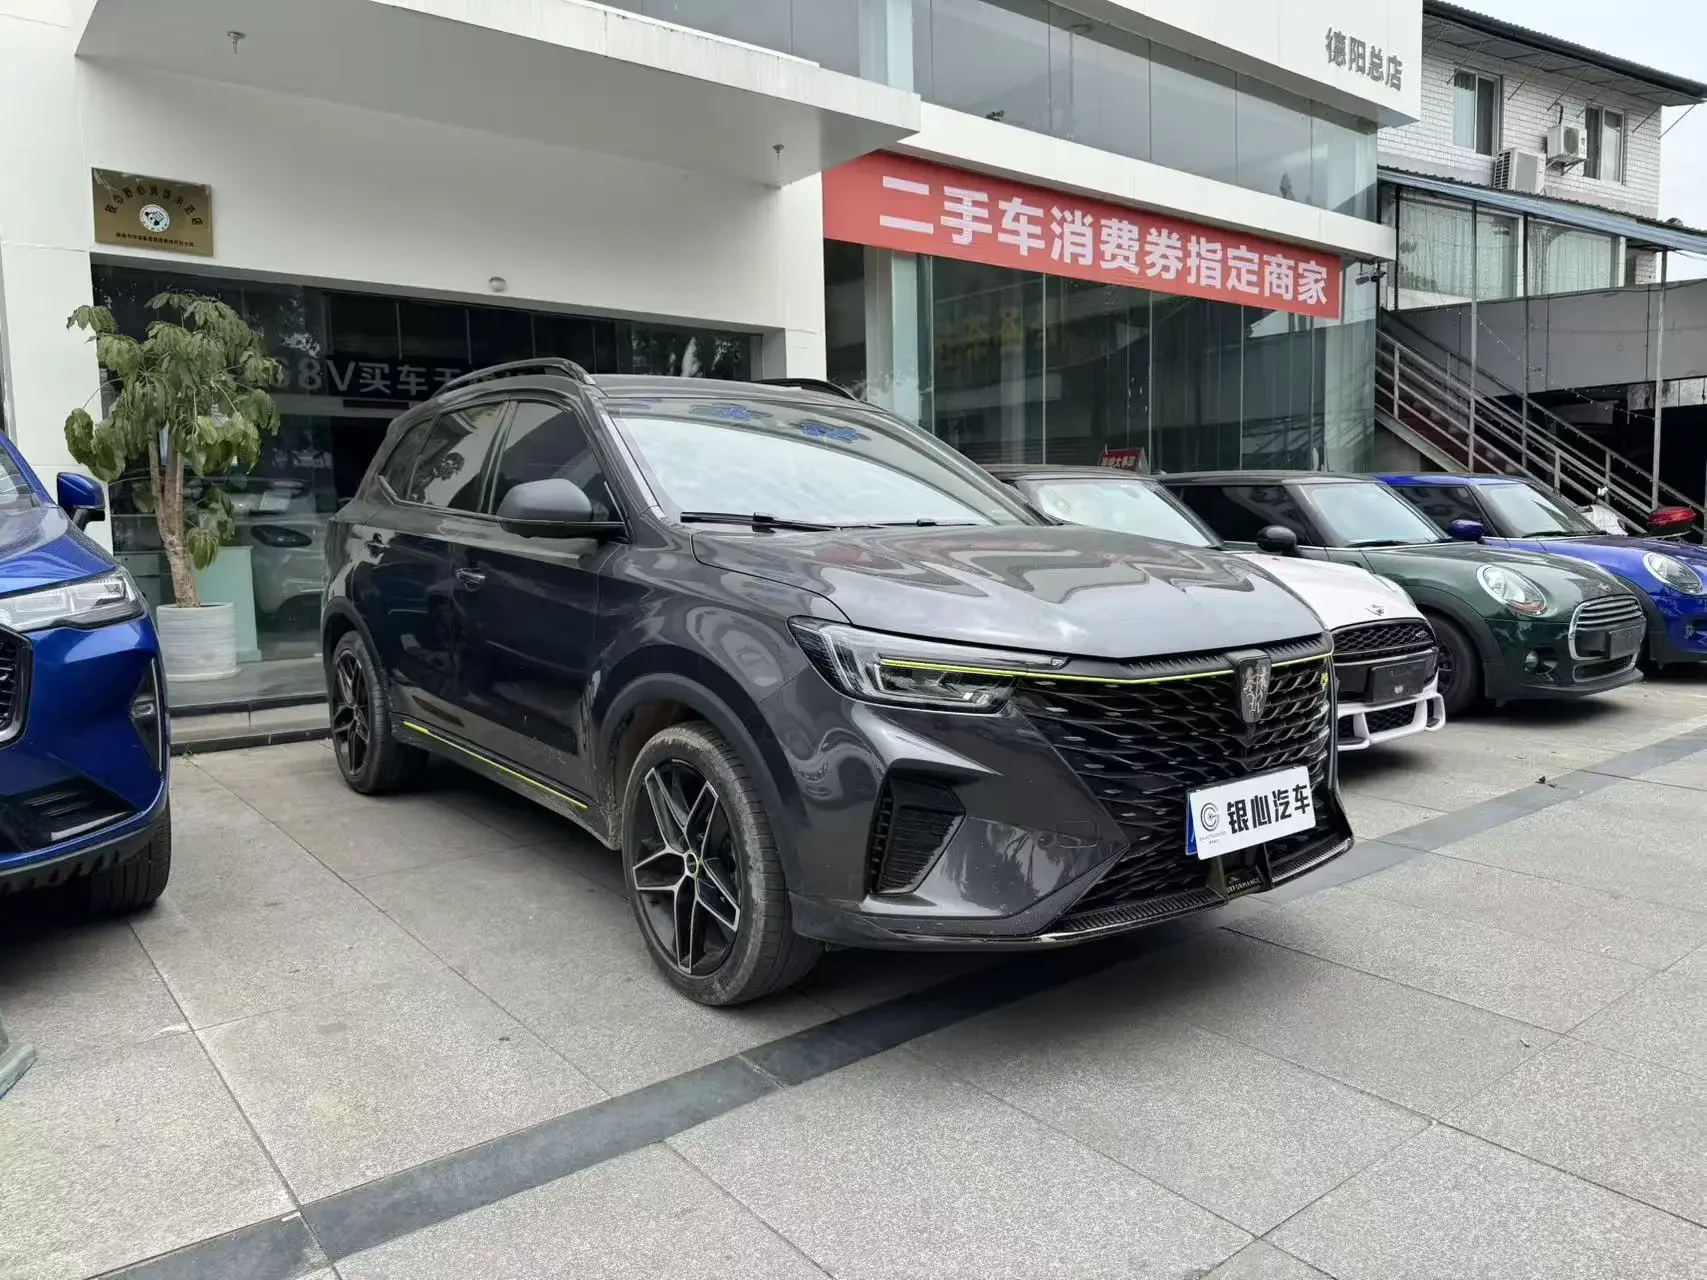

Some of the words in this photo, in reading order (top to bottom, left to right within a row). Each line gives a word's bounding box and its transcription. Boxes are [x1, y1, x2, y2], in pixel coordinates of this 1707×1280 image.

[1325, 27, 1403, 91] 德阳总店
[879, 175, 1328, 306] 二手车消费券指定商家
[1226, 784, 1311, 834] 银心汽车
